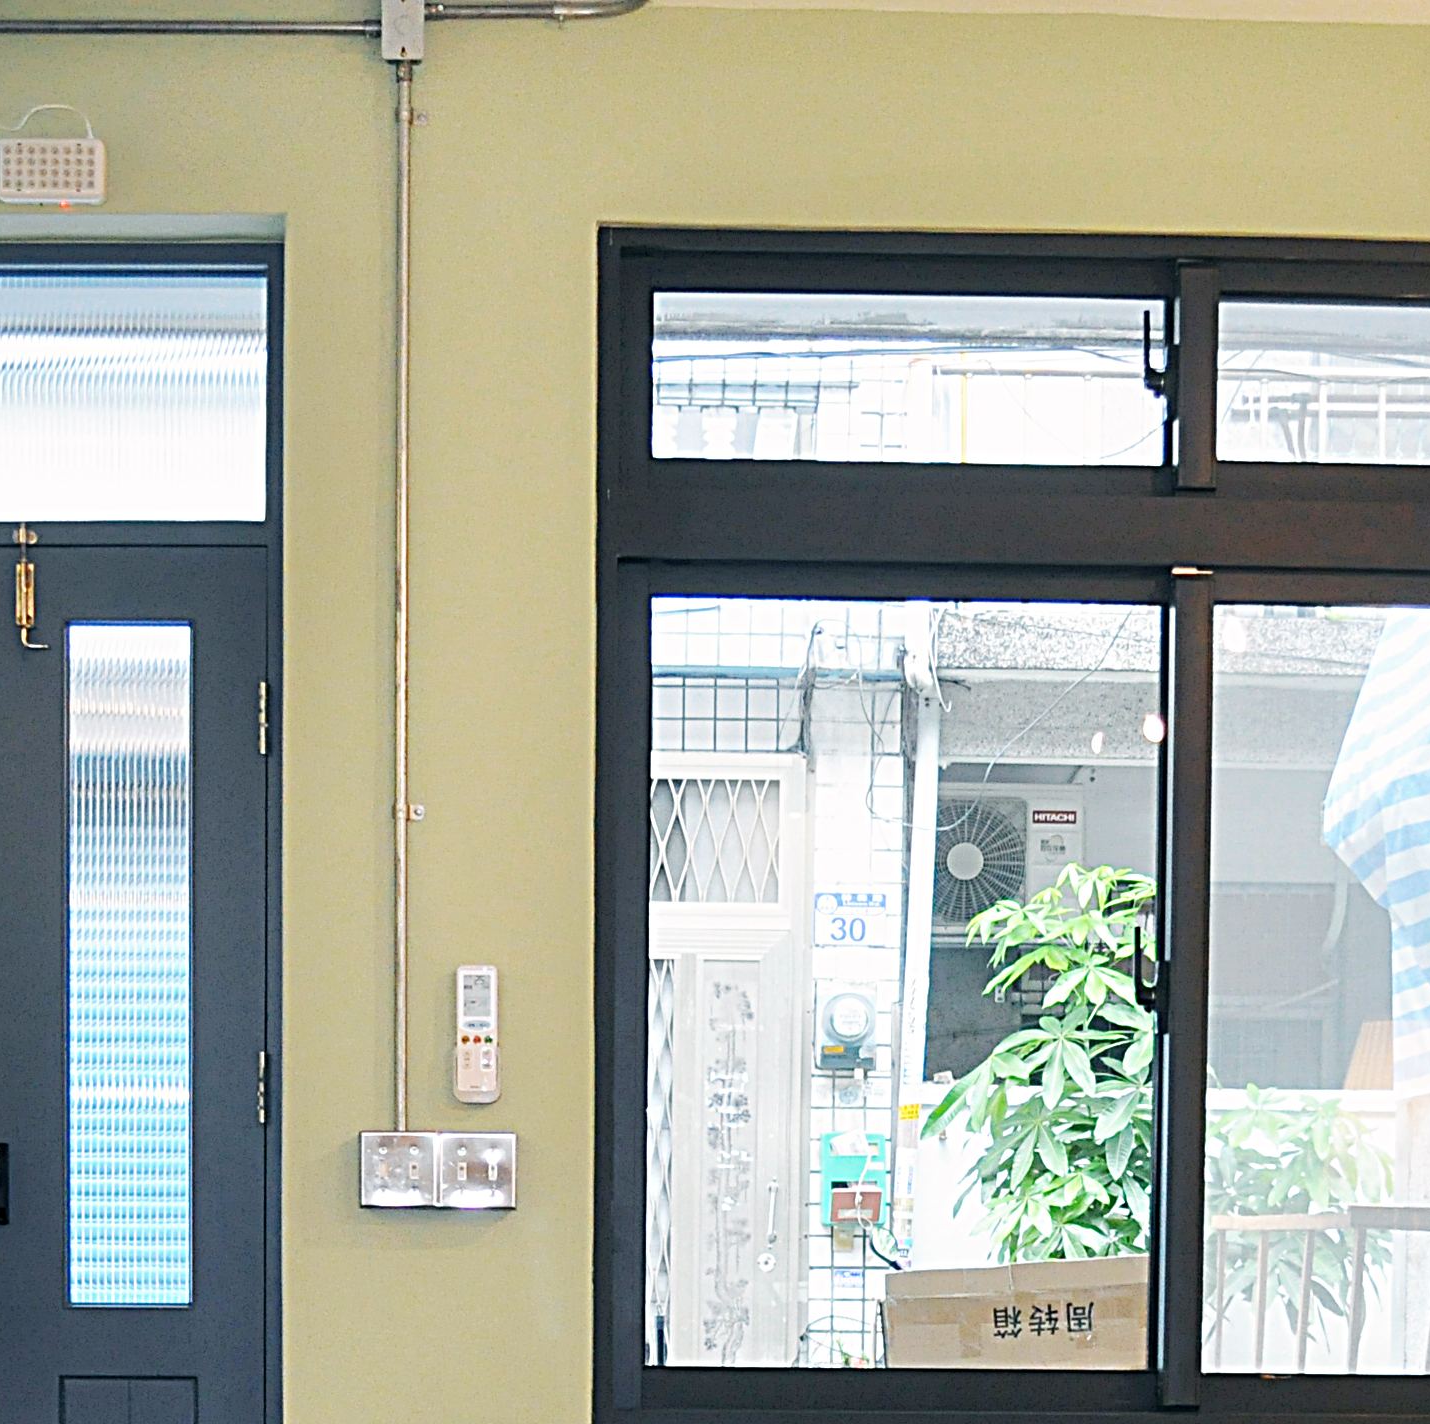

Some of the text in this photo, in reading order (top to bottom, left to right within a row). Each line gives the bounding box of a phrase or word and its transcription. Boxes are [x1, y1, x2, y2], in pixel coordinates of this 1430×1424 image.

[1034, 812, 1075, 822] HITACHI
[830, 917, 866, 942] 30
[993, 1301, 1094, 1339] 周转箱
